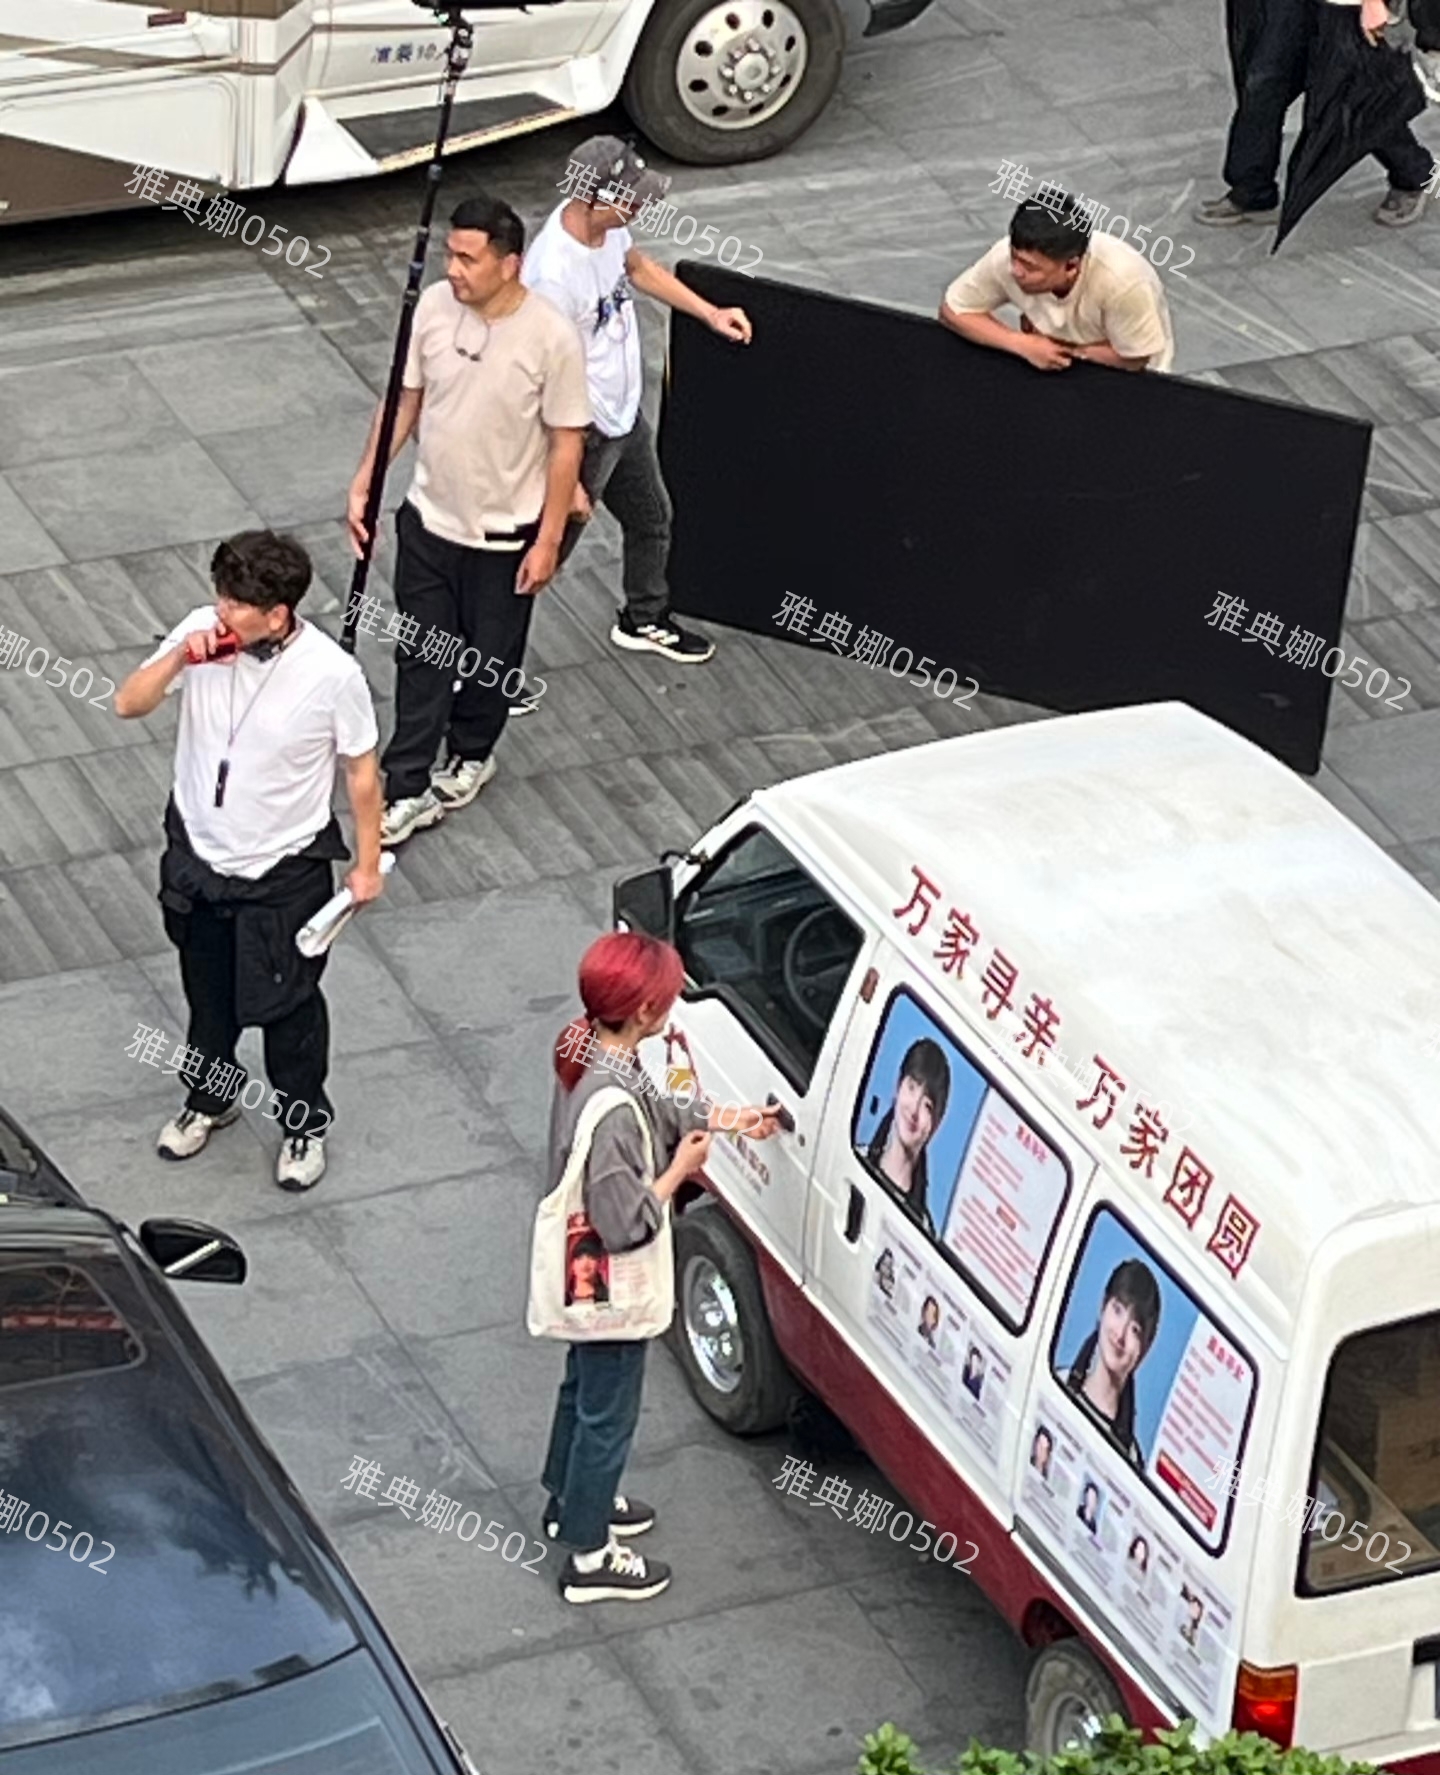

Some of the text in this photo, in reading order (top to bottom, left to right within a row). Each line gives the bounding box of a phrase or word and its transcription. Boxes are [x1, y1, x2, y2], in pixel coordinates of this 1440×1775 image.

[892, 864, 1063, 1066] 万家寻亲
[1076, 1053, 1261, 1279] 万家团圆
